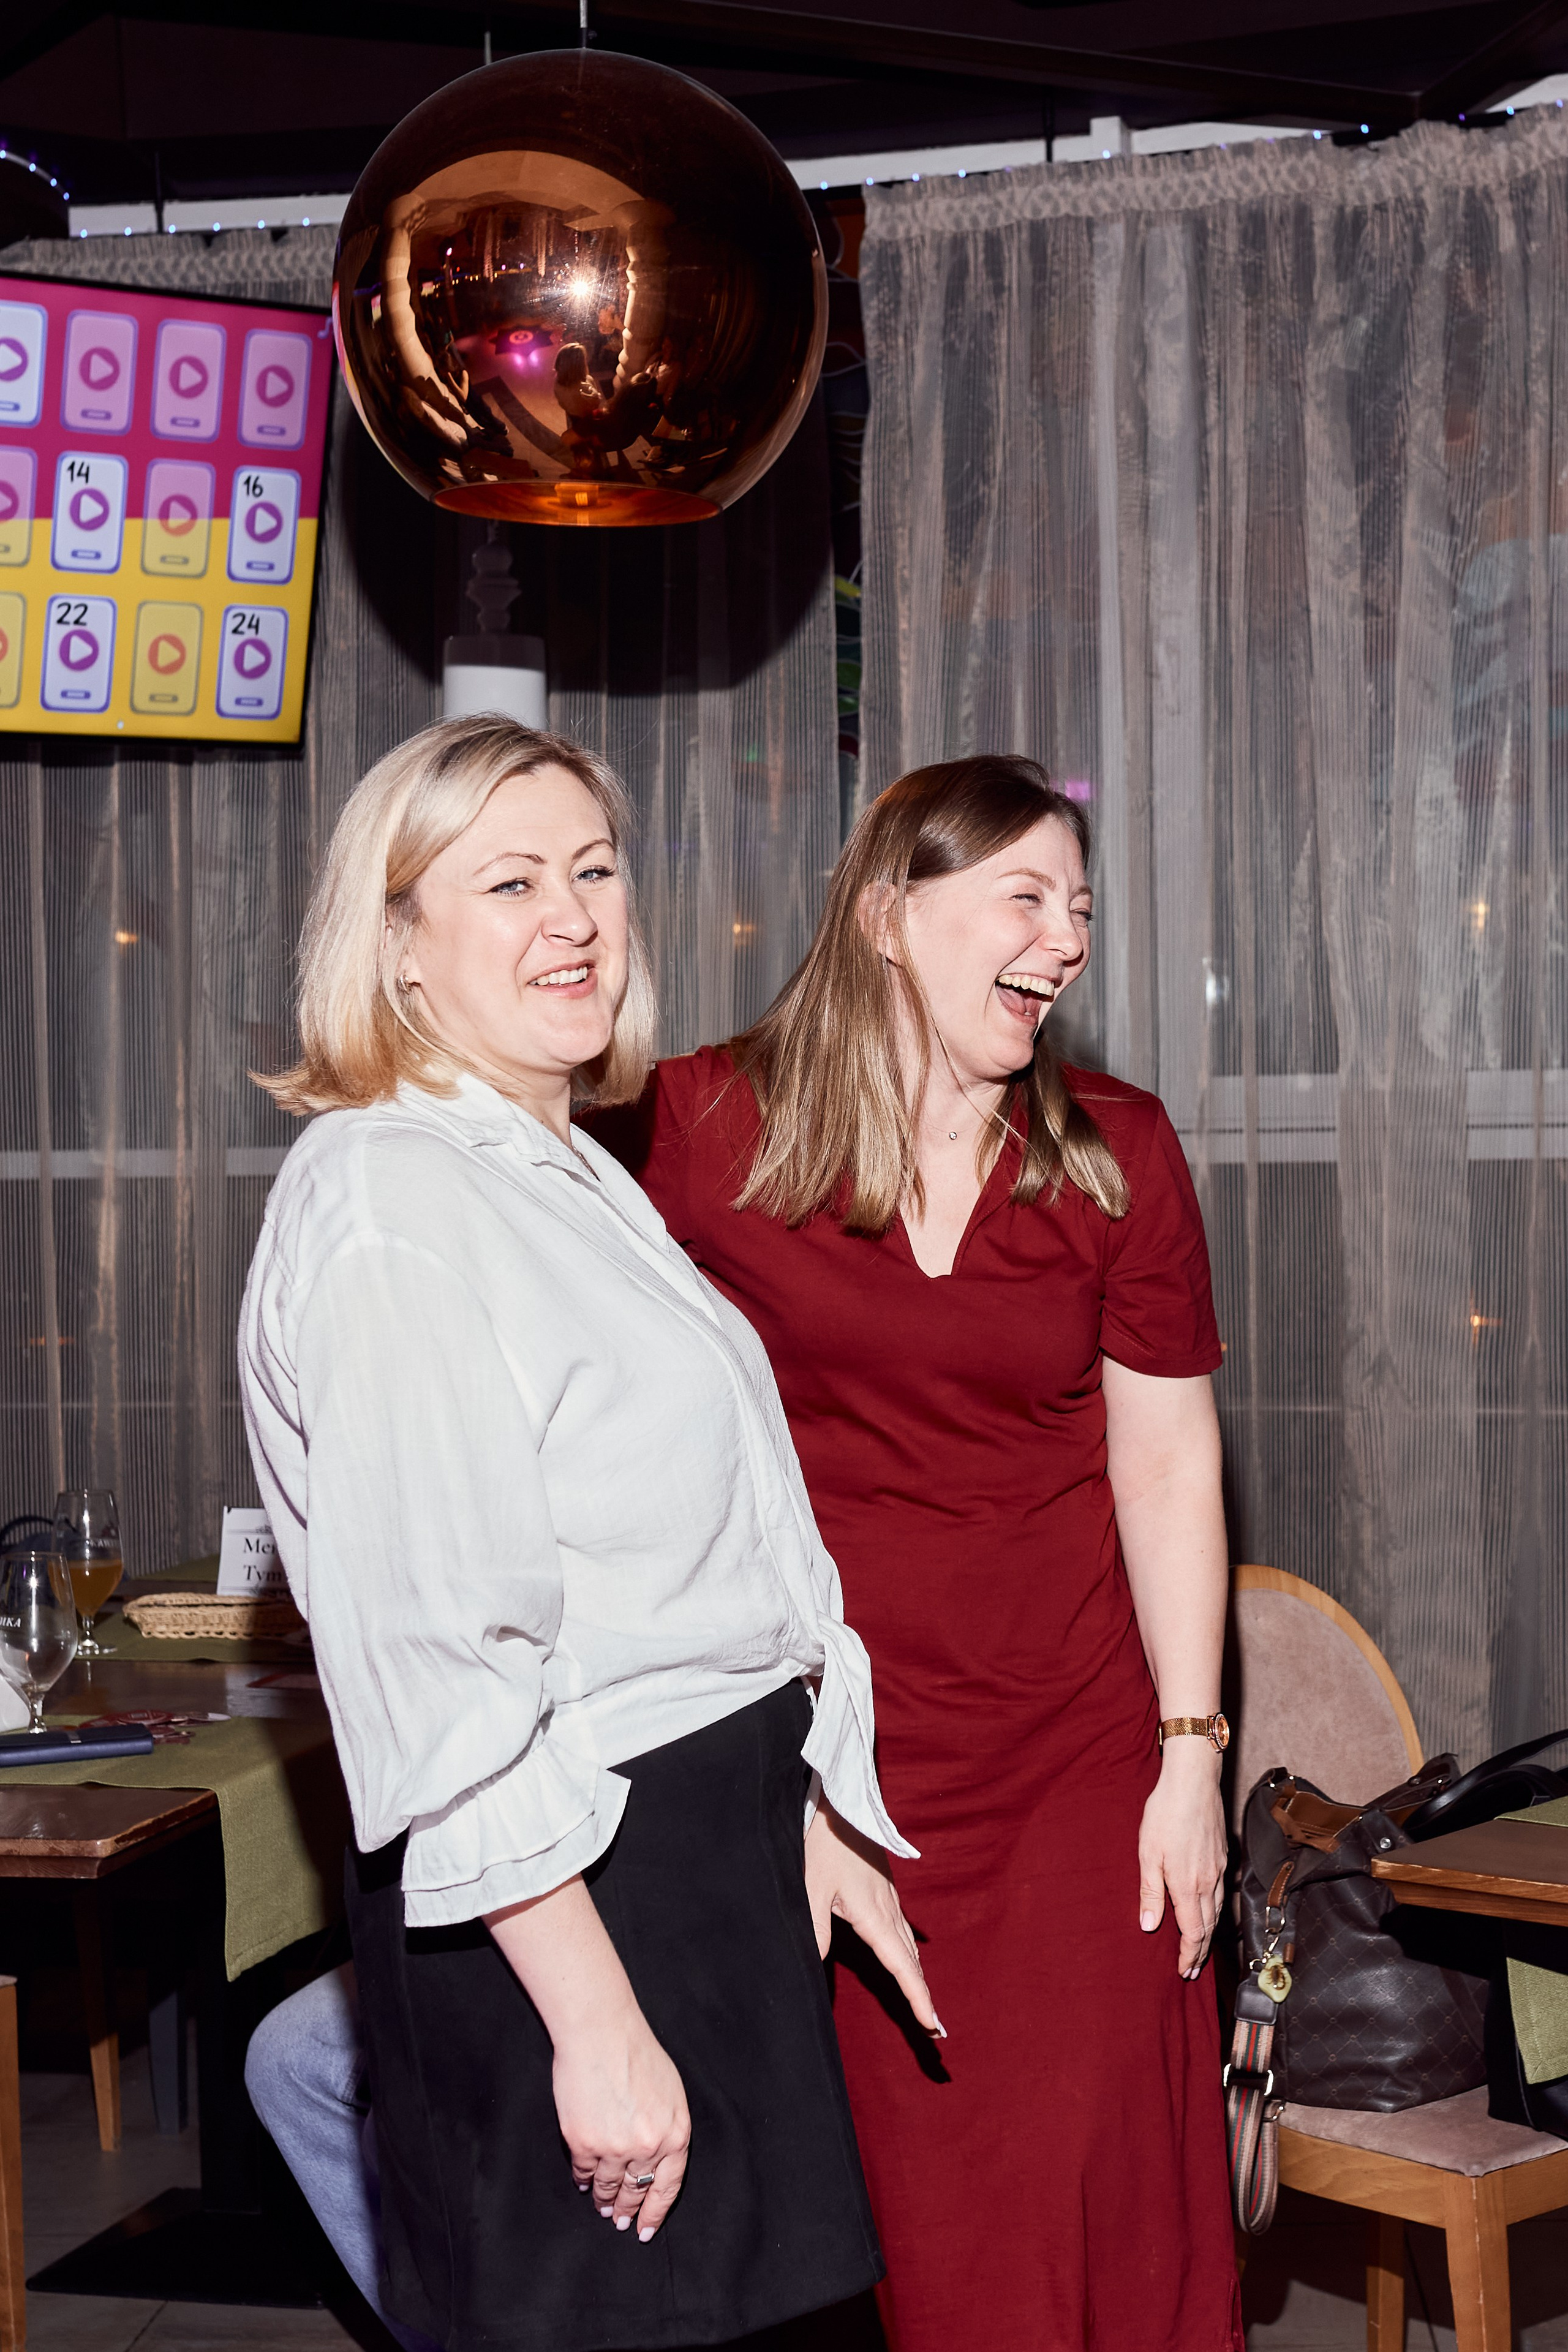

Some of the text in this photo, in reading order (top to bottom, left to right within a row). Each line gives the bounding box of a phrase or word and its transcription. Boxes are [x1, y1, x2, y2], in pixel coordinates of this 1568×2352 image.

[67, 461, 90, 484] 14
[244, 474, 263, 497] 16
[56, 601, 89, 626] 22
[231, 612, 260, 636] 24
